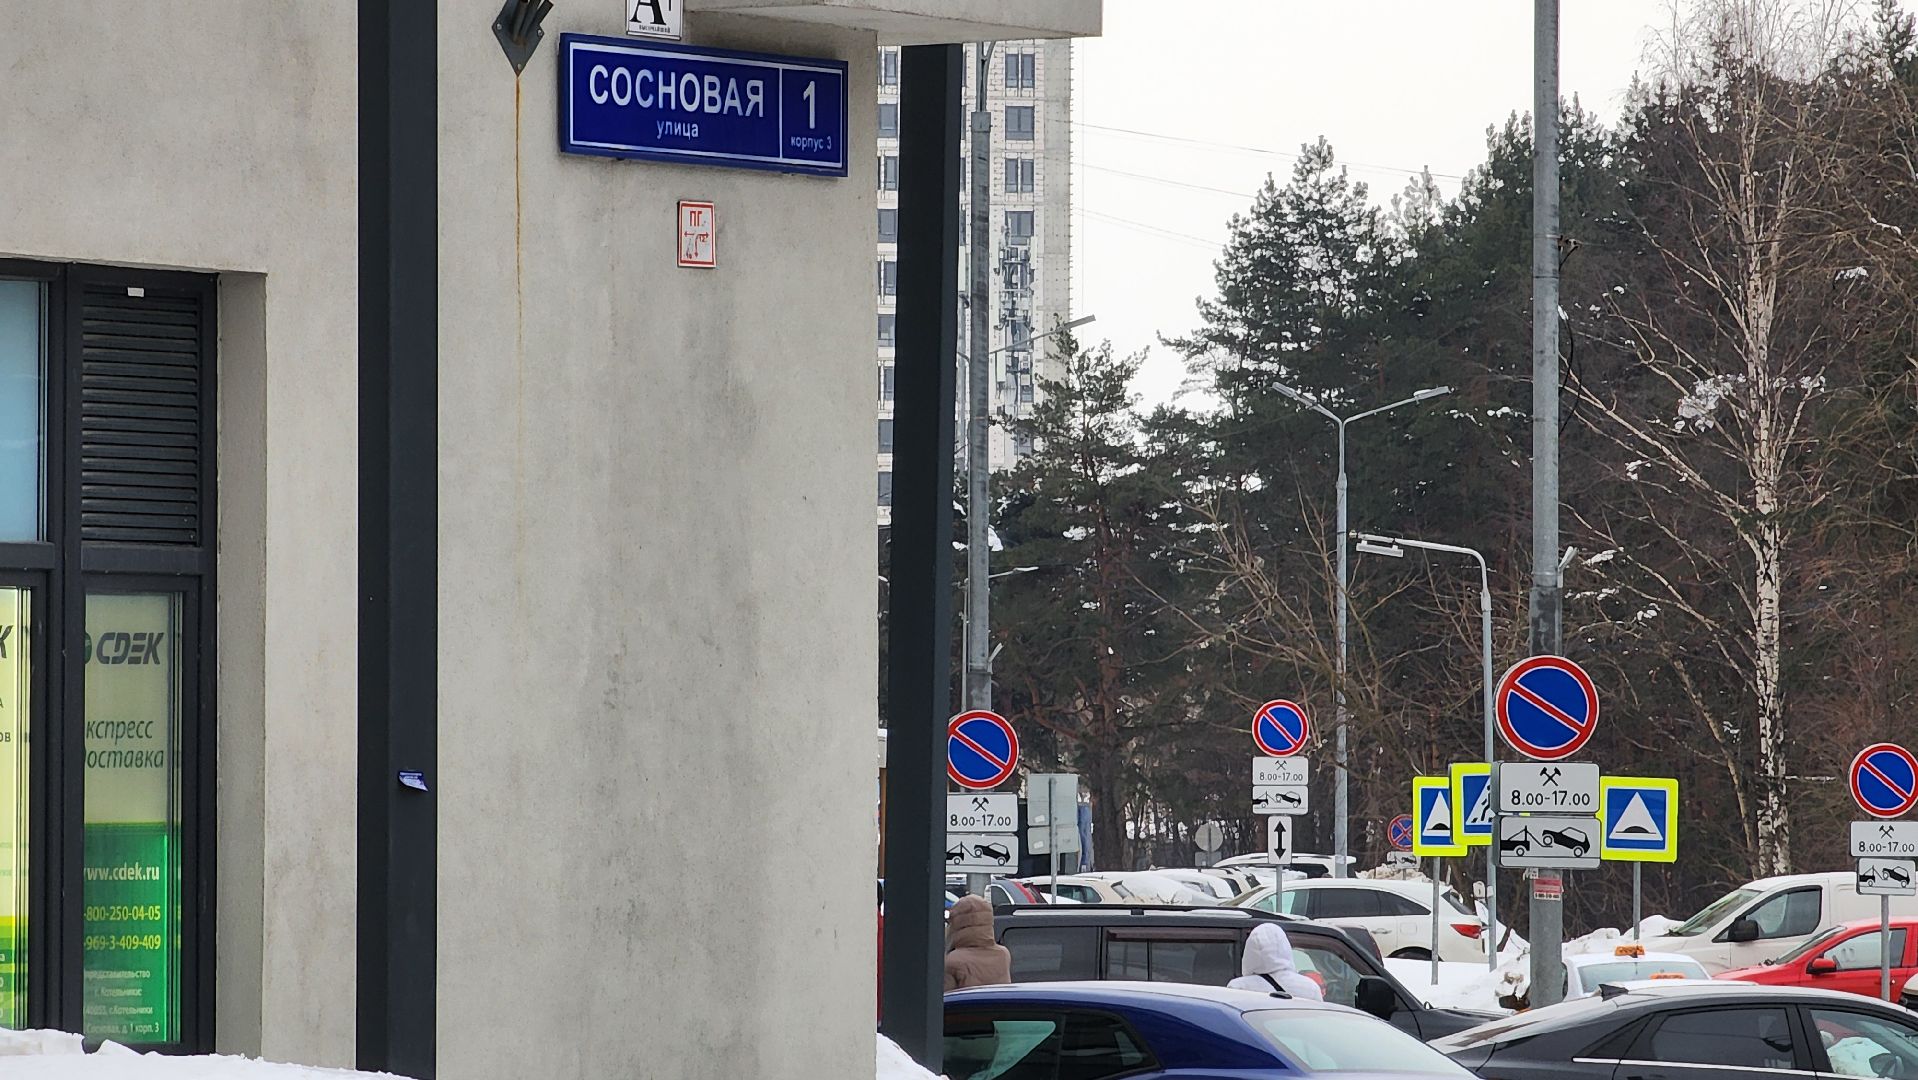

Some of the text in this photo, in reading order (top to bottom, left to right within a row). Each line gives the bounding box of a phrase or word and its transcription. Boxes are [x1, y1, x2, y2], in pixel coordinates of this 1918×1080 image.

[589, 64, 764, 118] СОСНОВАЯ
[803, 80, 815, 129] 1
[657, 120, 699, 140] улица
[790, 136, 832, 152] корпус 3
[96, 632, 165, 665] CDEK
[84, 749, 164, 769] оставка
[1259, 771, 1304, 781] 8.00-17.00
[1511, 789, 1591, 806] 8.00-17.00
[950, 814, 1012, 827] 8.00-17.00
[1858, 840, 1915, 853] 8.00-17.00
[84, 861, 160, 881] ww.cdek.ru
[154, 1022, 160, 1033] 3
